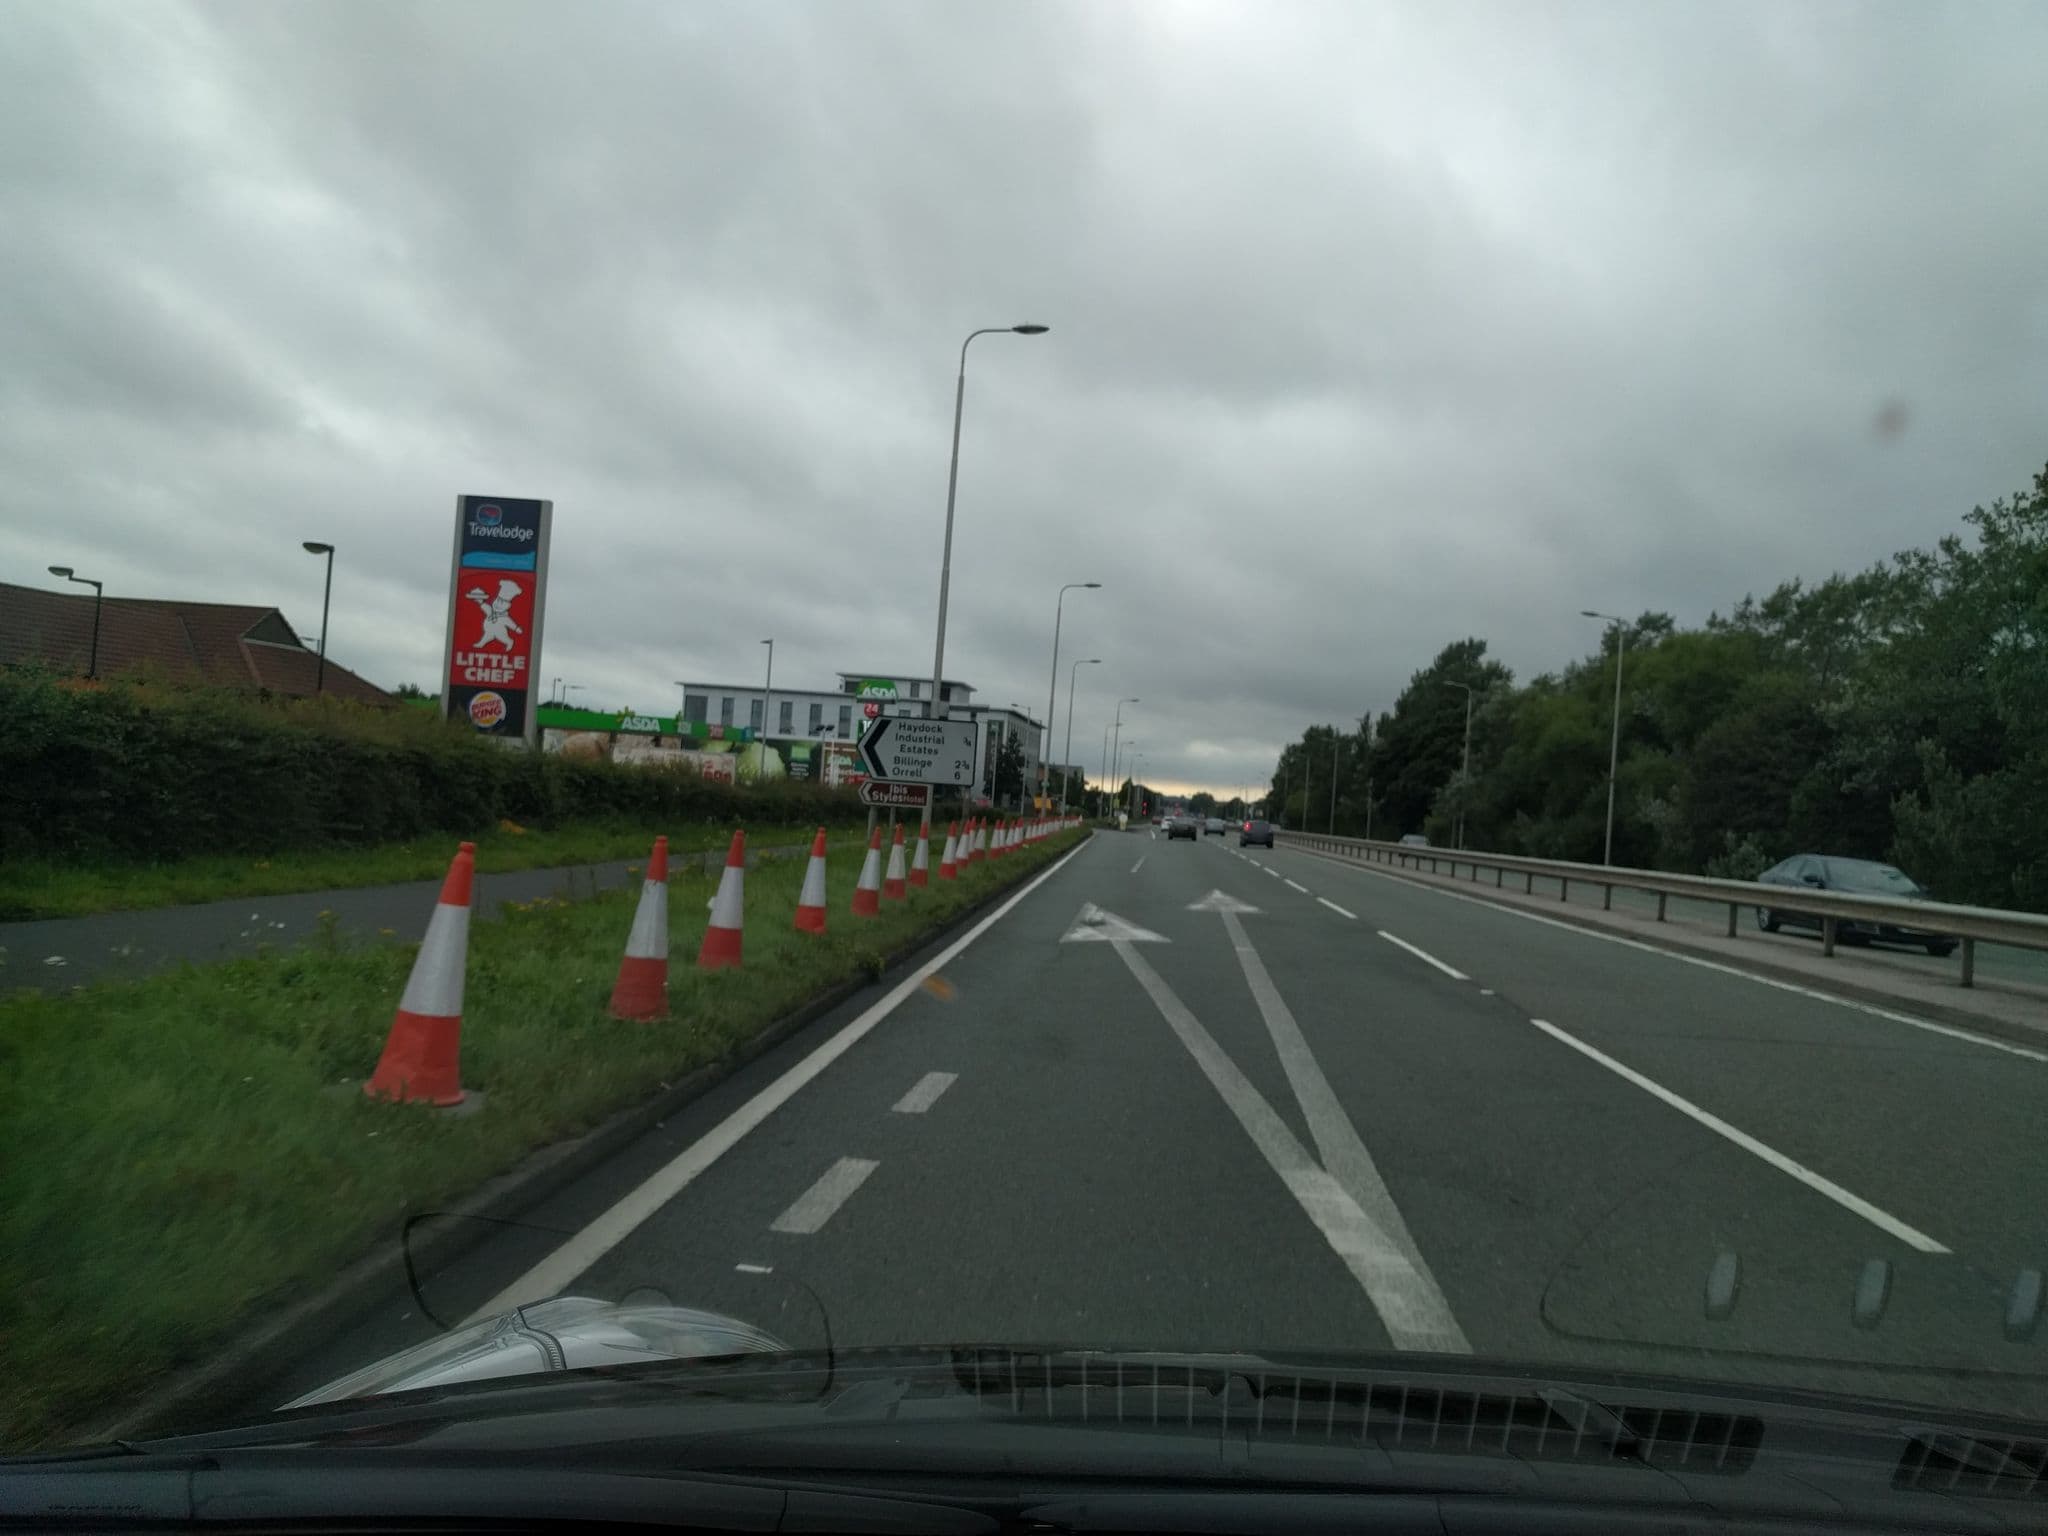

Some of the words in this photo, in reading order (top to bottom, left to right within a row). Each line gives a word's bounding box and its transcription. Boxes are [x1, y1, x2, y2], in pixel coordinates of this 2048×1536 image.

[469, 521, 535, 542] Travelodge
[456, 652, 526, 670] LITTLE
[465, 667, 516, 684] CHEF
[862, 686, 897, 698] ASDA
[621, 717, 661, 732] ASDA
[898, 722, 943, 733] Haydock
[895, 733, 945, 745] Industrial
[900, 744, 939, 755] Estates
[893, 756, 933, 768] Billinge
[892, 766, 922, 777] Orrell
[954, 771, 961, 780] 6
[872, 790, 904, 803] Styles
